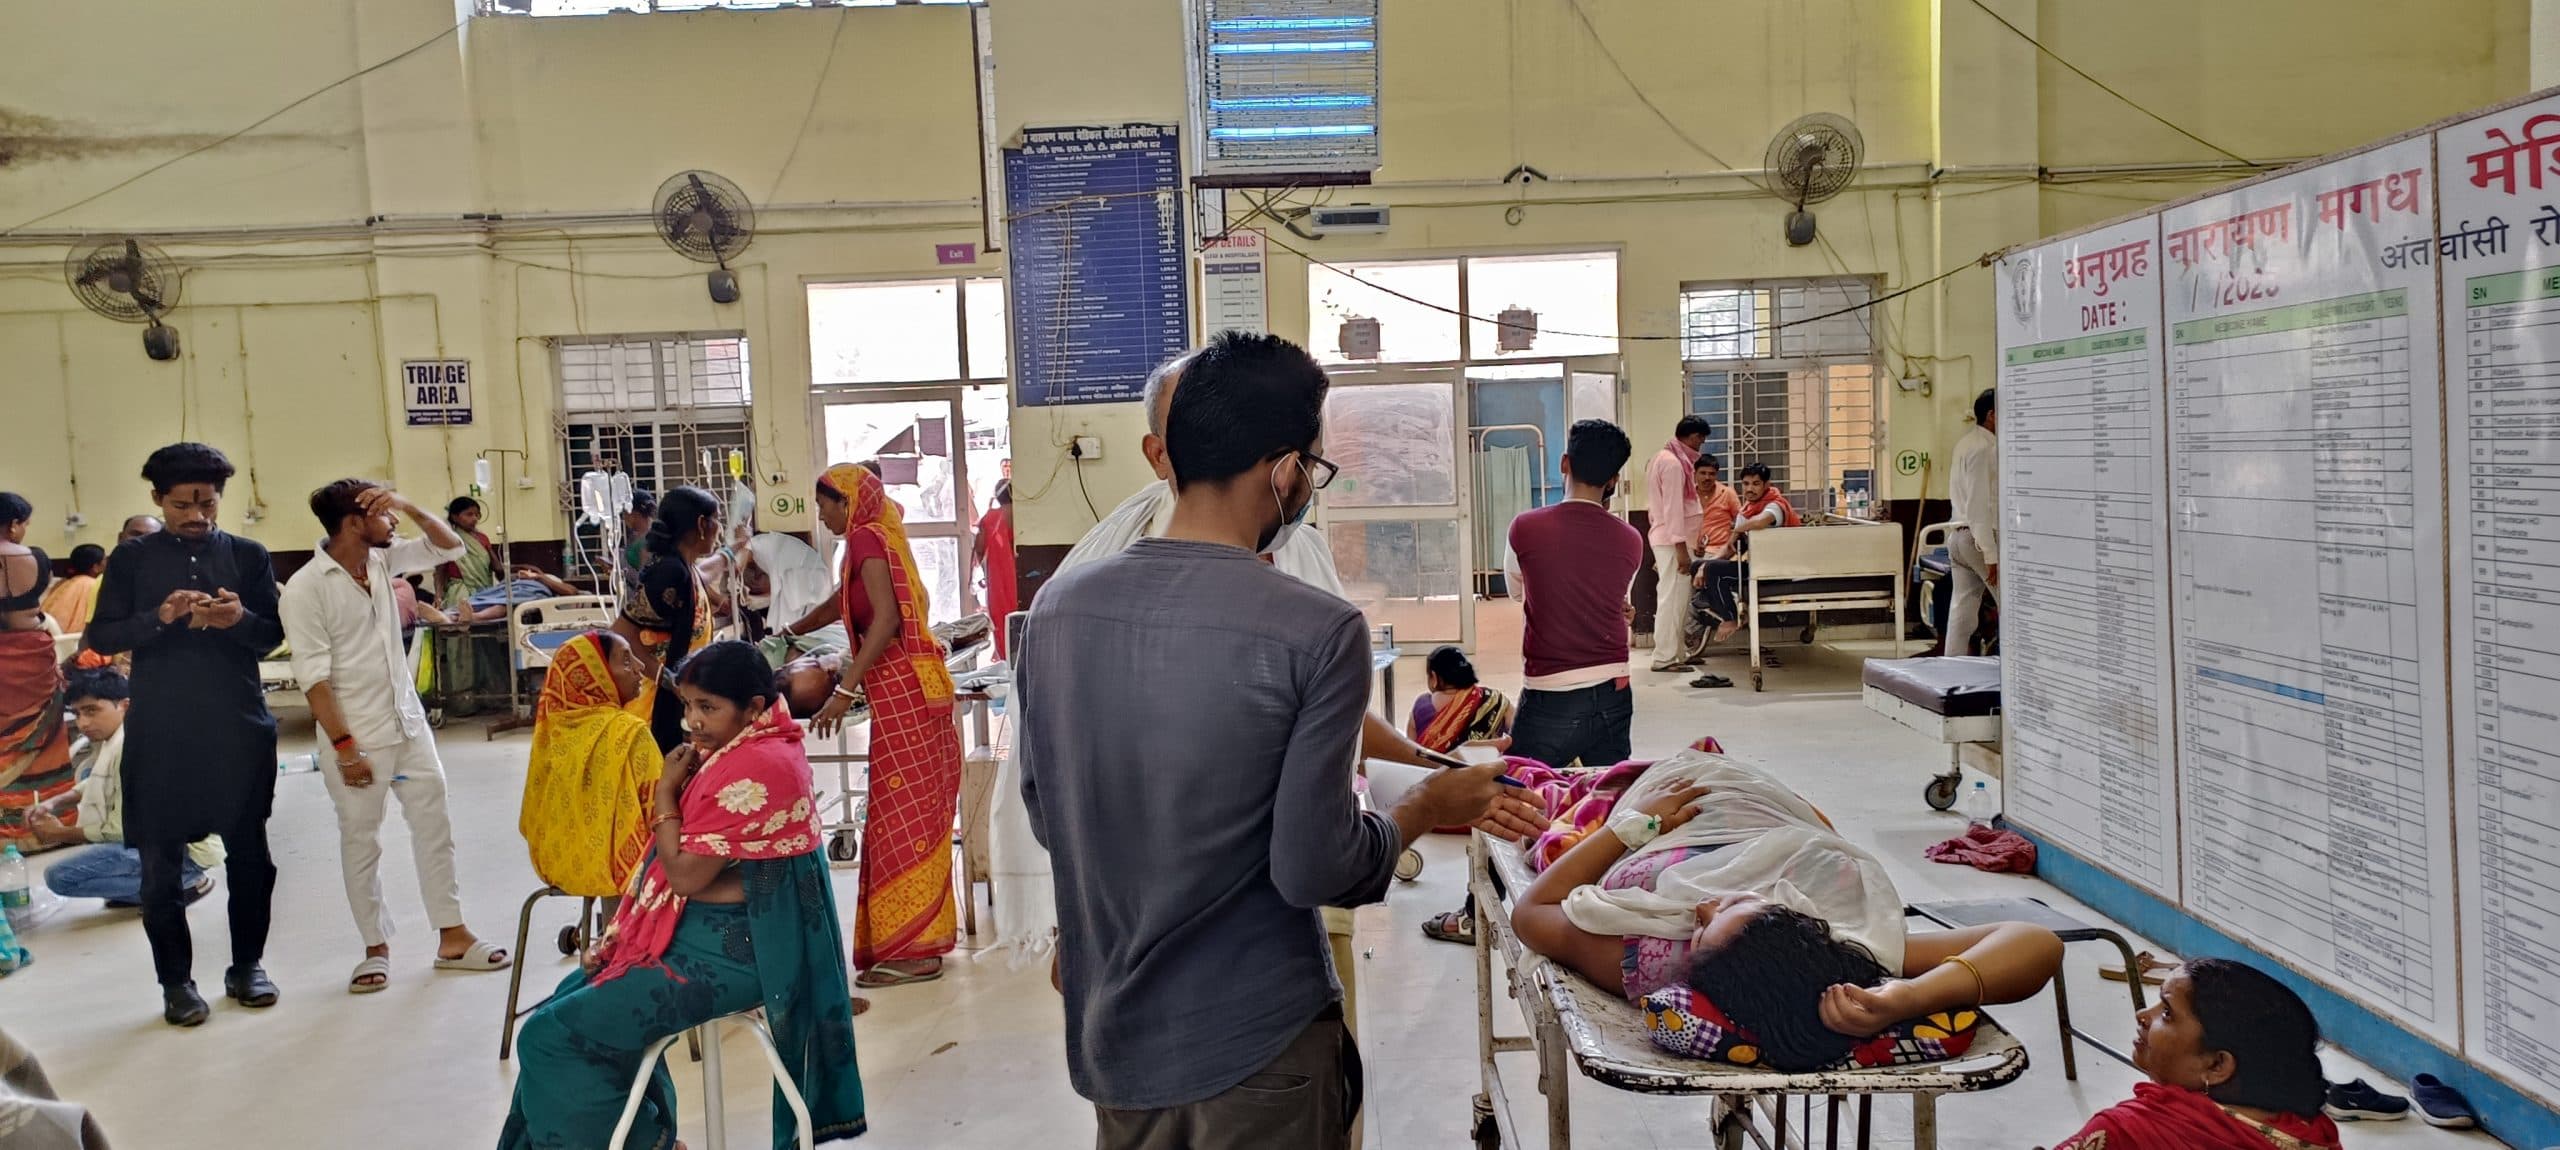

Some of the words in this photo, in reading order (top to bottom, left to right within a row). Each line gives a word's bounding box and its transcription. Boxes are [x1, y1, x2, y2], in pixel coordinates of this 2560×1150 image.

[2062, 240, 2150, 296] अनुग्रह
[2167, 203, 2292, 267] नारायण
[2316, 168, 2423, 231] मगध
[1221, 235, 1256, 248] DETAILS
[949, 249, 964, 259] Exit
[2472, 287, 2487, 300] SN
[406, 365, 466, 384] TRIAGE
[417, 386, 459, 405] AREA
[1902, 455, 1917, 470] 12
[1921, 452, 1929, 468] H
[777, 498, 789, 513] 9
[796, 497, 805, 513] H
